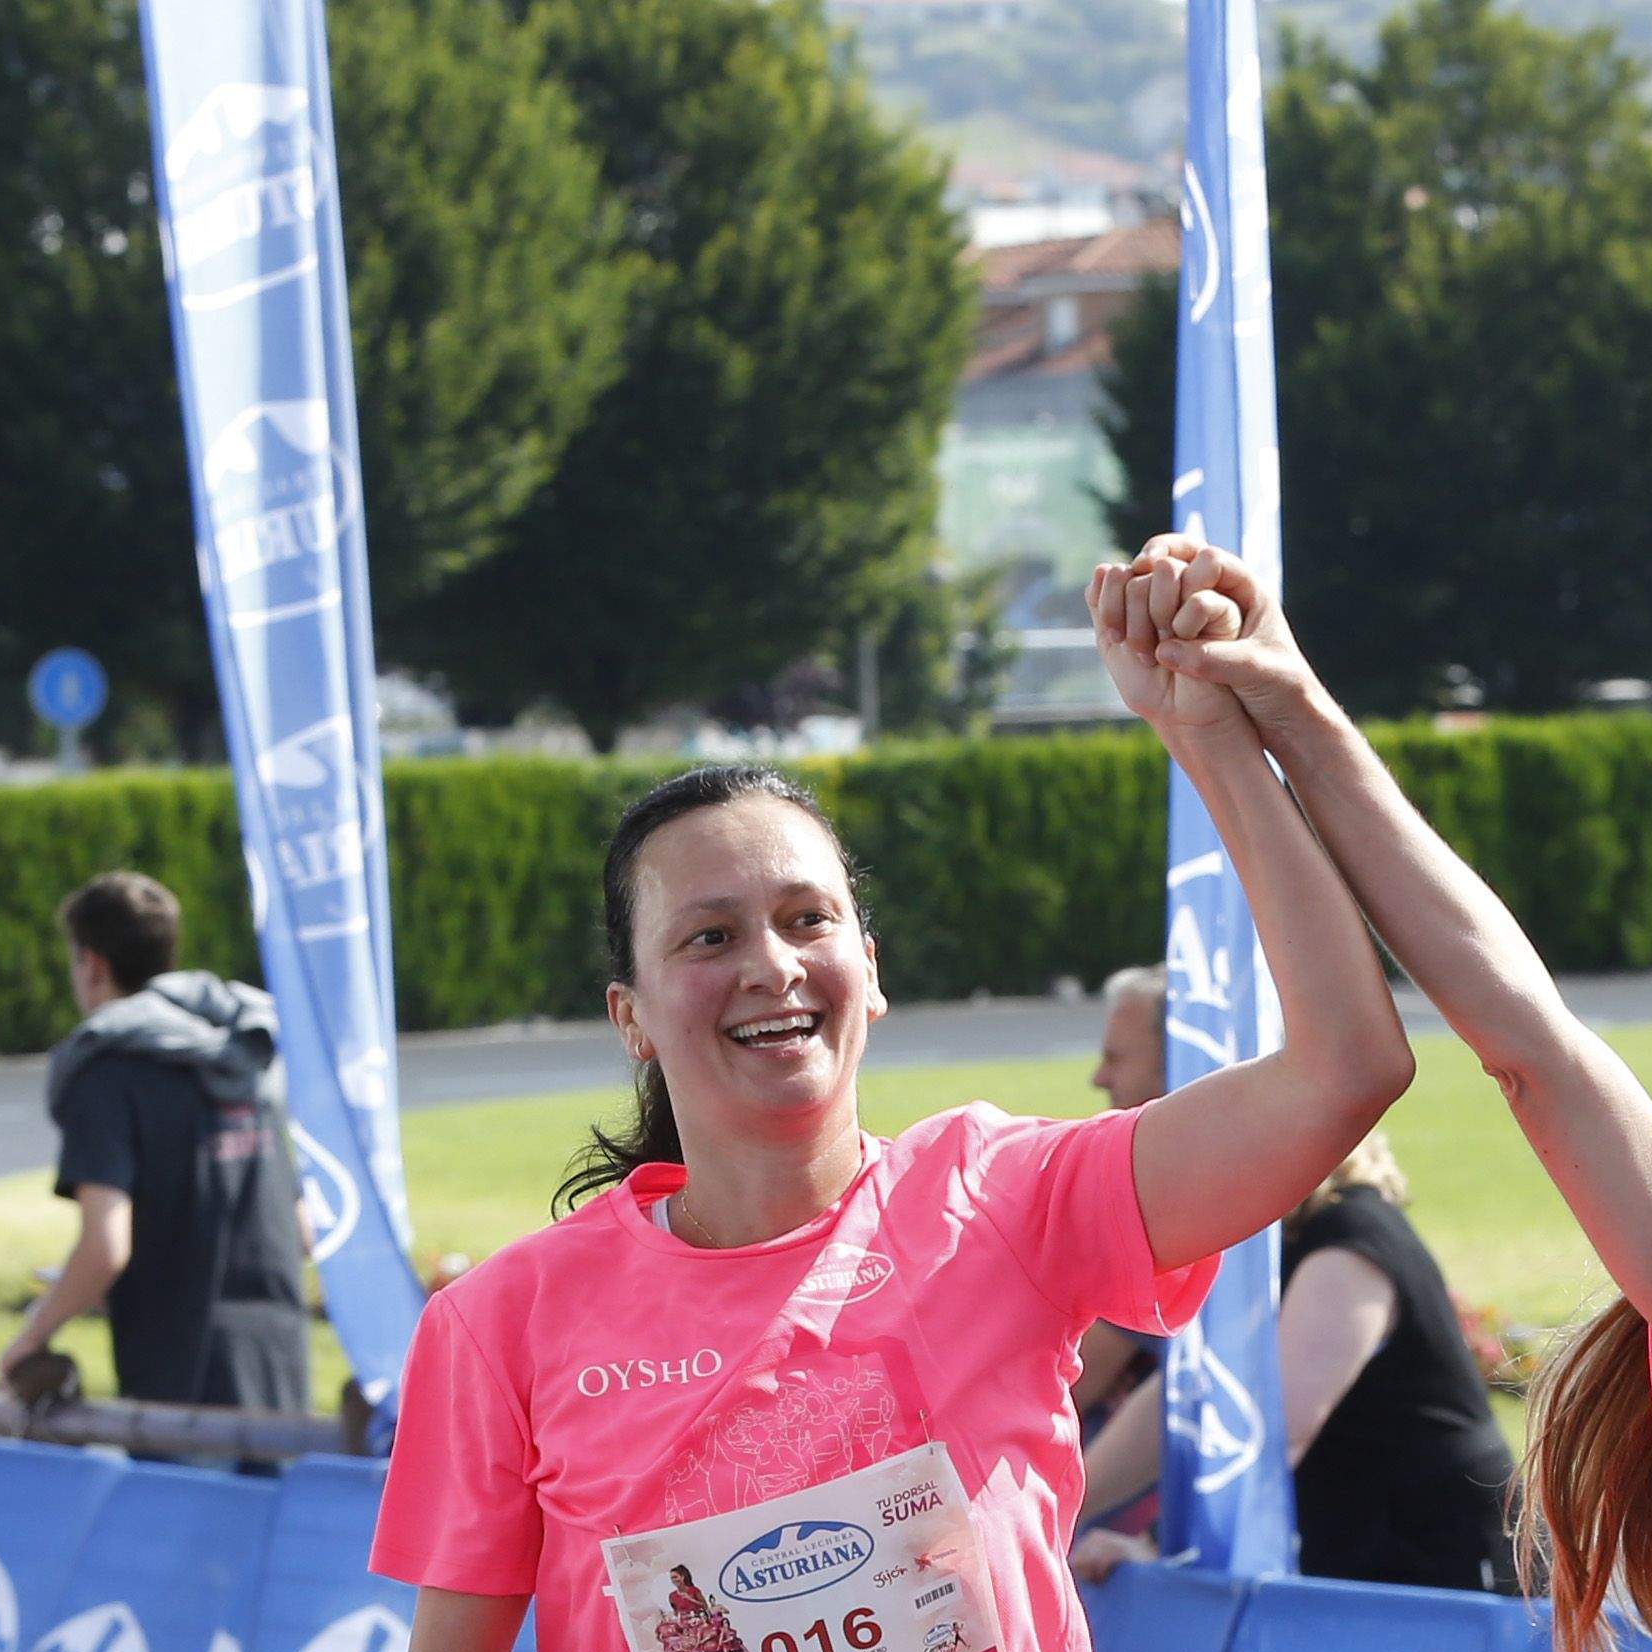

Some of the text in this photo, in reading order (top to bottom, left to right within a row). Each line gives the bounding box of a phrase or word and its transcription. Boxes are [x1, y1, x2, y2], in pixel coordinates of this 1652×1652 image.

[577, 1348, 722, 1397] OYSHO
[876, 1480, 938, 1511] TU DORSAL
[882, 1492, 943, 1527] SUMA
[751, 1531, 855, 1567] CENTRAL LECHERA
[734, 1541, 866, 1595] ASTURIANA
